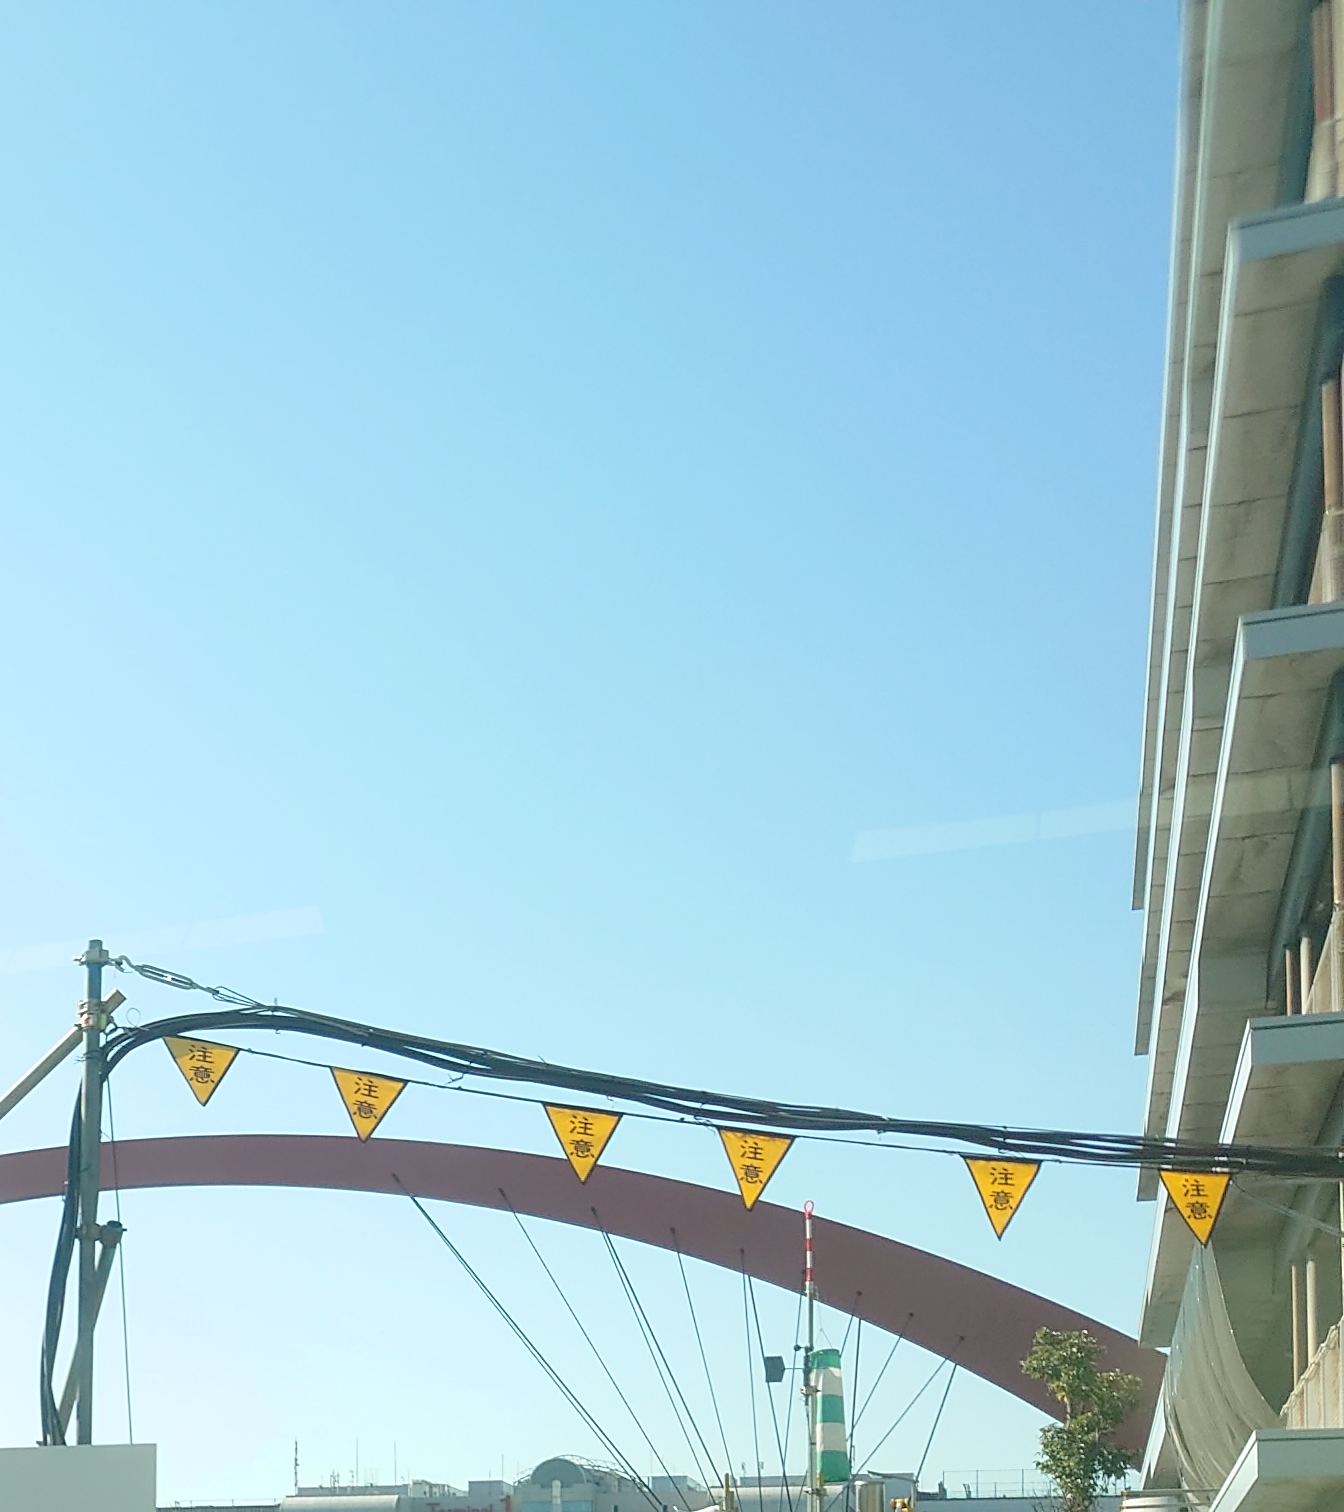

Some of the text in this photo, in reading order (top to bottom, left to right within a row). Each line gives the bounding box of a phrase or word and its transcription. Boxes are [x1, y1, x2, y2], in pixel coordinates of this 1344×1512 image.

[188, 1044, 215, 1084] 注意
[352, 1076, 379, 1119] 注意
[569, 1115, 595, 1158] 注意
[739, 1139, 765, 1184] 注意
[988, 1166, 1015, 1211] 注意
[1182, 1178, 1213, 1220] 注意
